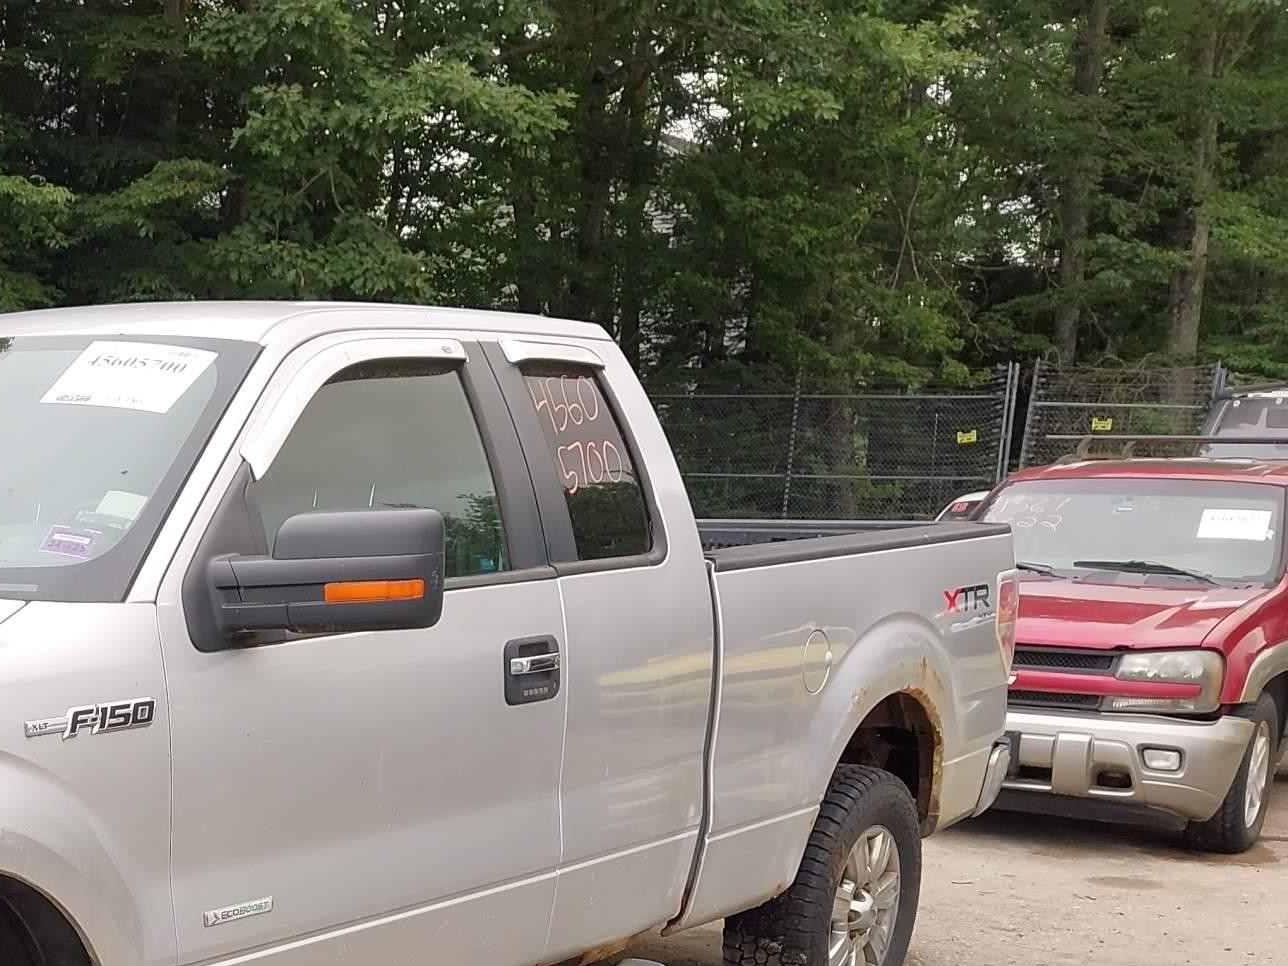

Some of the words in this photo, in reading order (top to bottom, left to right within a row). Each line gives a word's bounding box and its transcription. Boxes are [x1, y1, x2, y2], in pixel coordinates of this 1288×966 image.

[88, 354, 187, 373] 45605700
[528, 375, 599, 434] 4560
[558, 440, 623, 493] 5700
[31, 722, 49, 732] XLT
[66, 699, 155, 736] F-150
